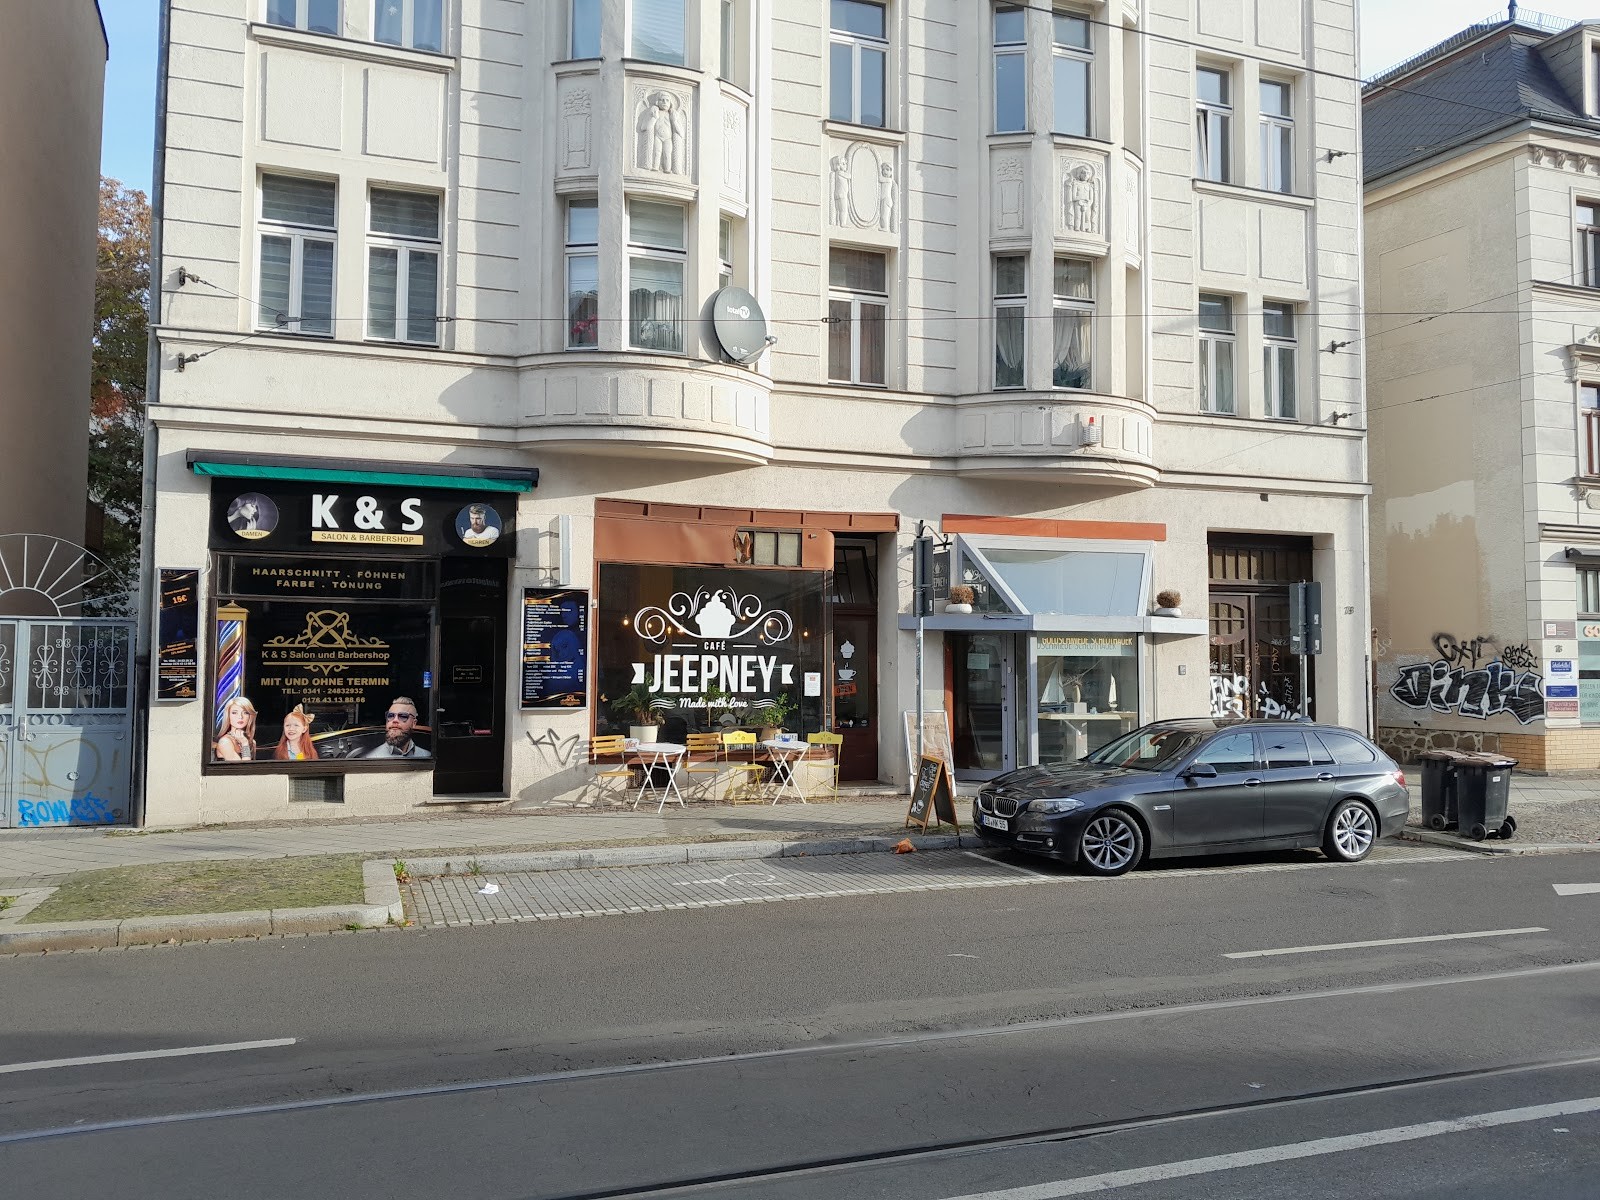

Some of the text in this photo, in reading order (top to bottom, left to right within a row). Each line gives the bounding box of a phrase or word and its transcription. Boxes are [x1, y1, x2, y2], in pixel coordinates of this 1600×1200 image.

[312, 494, 424, 532] K & S
[321, 532, 415, 543] SALON & BARBERSHOP
[252, 568, 341, 578] HAARSCHNITT
[357, 570, 406, 580] FÖHNEN
[276, 580, 315, 588] FARBE
[332, 580, 382, 590] TÖNUNG
[703, 640, 726, 650] CAFÉ
[261, 651, 390, 660] K & S Salon und Barbershop
[648, 654, 777, 693] JEEPNEY
[260, 678, 390, 686] MIT UND OHNE TERMIN
[679, 697, 748, 708] Made with Love
